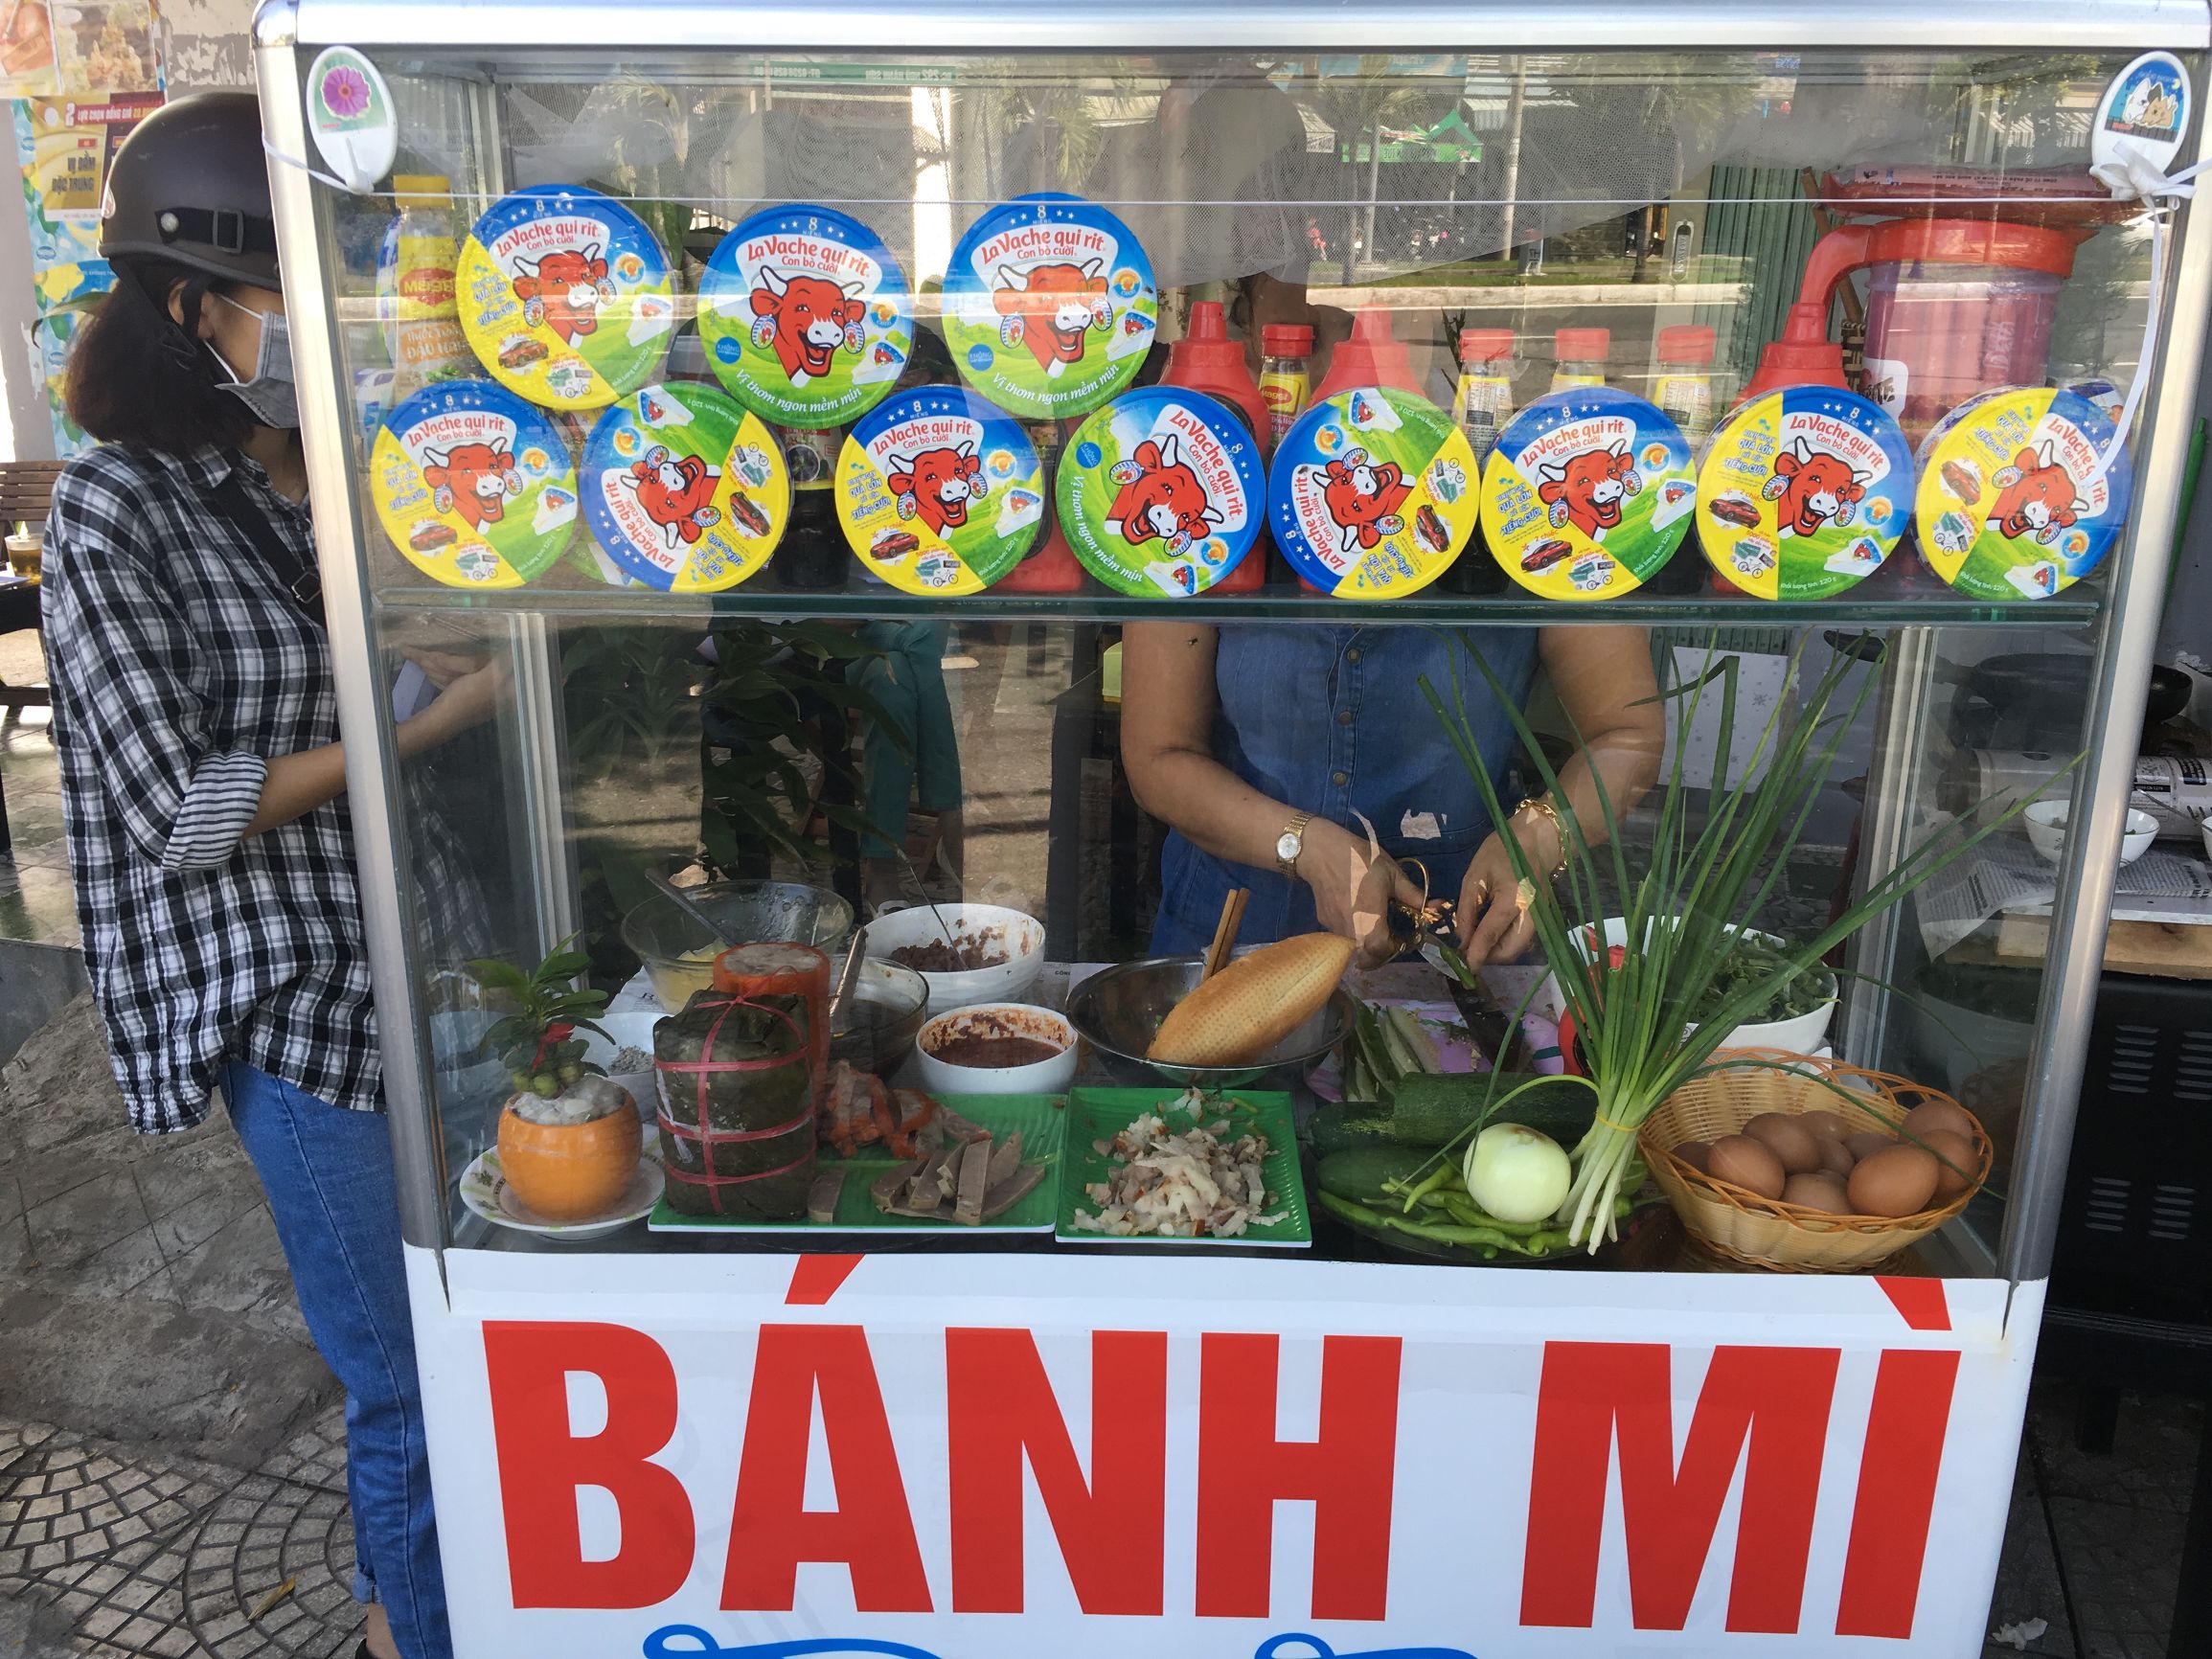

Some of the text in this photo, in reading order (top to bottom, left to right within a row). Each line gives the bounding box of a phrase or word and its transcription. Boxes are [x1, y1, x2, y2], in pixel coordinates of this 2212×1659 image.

[536, 200, 544, 211] 8
[1038, 205, 1046, 217] 8
[810, 217, 817, 230] 8
[497, 241, 512, 258] La
[509, 221, 553, 245] Vache
[556, 220, 578, 238] qui
[527, 241, 542, 251] Con
[982, 229, 1104, 263] La Vache qui rit
[747, 236, 870, 276] La Vache qui rit
[782, 256, 800, 266] Con
[804, 255, 814, 267] bò
[1017, 249, 1036, 260] Con
[1038, 247, 1050, 256] bò
[737, 369, 861, 412] Vị thơm ngon mềm mịn
[993, 364, 1120, 404] Vị thơm ngon mềm mịn
[913, 400, 922, 412] 8
[1562, 407, 1571, 418] 8
[1850, 407, 1860, 418] 8
[408, 433, 422, 446] La
[421, 415, 462, 437] Vache
[465, 415, 486, 430] qui
[437, 433, 452, 442] Con
[874, 420, 972, 456] La Vache qui rit
[903, 439, 918, 449] Con
[920, 436, 930, 444] bò
[1232, 443, 1243, 454] 8
[1522, 420, 1625, 468] La Vache qui rit
[1553, 445, 1568, 456] Con
[1570, 440, 1581, 449] bò
[1790, 415, 1884, 468] La Vache qui rit
[1816, 434, 1832, 445] Con
[1833, 440, 1843, 450] bò
[2100, 438, 2110, 448] 8
[1188, 444, 1202, 463] Con
[1200, 461, 1211, 475] bò
[2063, 446, 2074, 461] Con
[1170, 410, 1243, 516] La Vache qui rit
[2046, 419, 2064, 434] La
[2063, 425, 2091, 465] Vache
[2093, 488, 2106, 504] rit
[611, 500, 630, 520] qui
[1295, 477, 1346, 570] La Vache qui rit
[1316, 515, 1326, 526] bò
[645, 528, 656, 541] Con
[1071, 476, 1143, 582] Vị thơm ngon mềm mịn
[1286, 531, 1296, 539] 8
[1323, 528, 1334, 542] Con
[627, 522, 659, 560] Vache
[659, 554, 674, 568] La
[483, 1255, 1960, 1636] BÁNH MÌ
